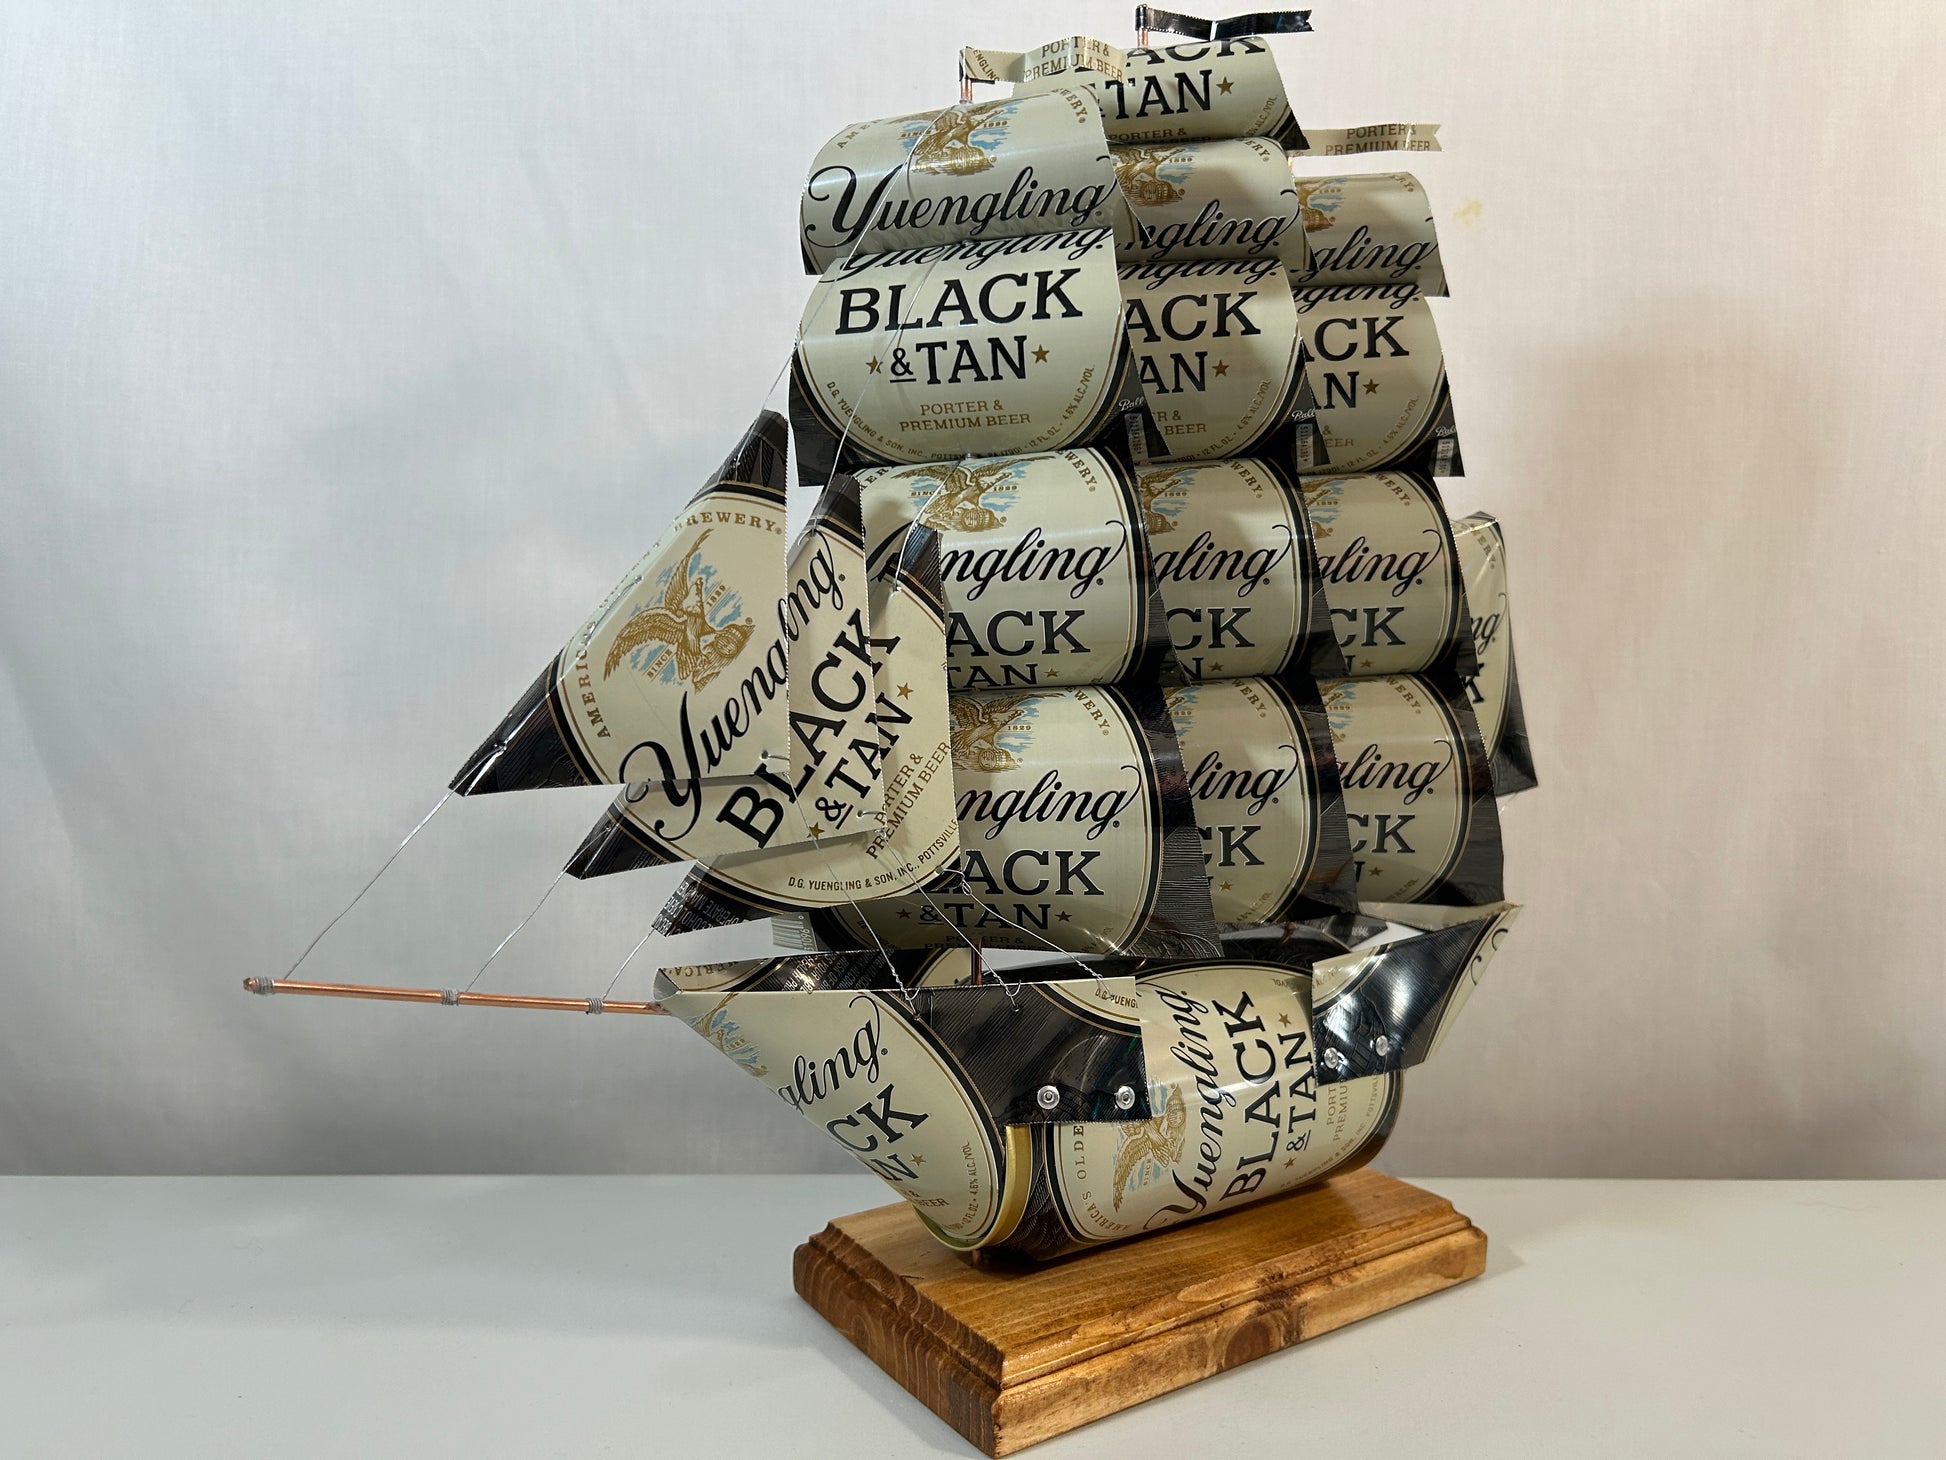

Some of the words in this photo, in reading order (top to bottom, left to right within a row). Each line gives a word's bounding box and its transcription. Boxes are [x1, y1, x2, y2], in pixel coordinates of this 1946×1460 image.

[804, 155, 1118, 247] Yuengling
[835, 268, 1083, 335] BLACK
[899, 416, 983, 432] PREMIUM
[986, 413, 1032, 427] BEER
[920, 401, 988, 416] PORTER
[993, 400, 1004, 411] &
[1164, 424, 1207, 435] BEER
[941, 520, 1127, 601] ngling
[910, 753, 924, 766] &
[917, 741, 952, 785] BEER
[1188, 744, 1300, 816] ling
[788, 876, 805, 889] D.G.
[865, 878, 872, 887] &
[1210, 991, 1280, 1201] BLACK
